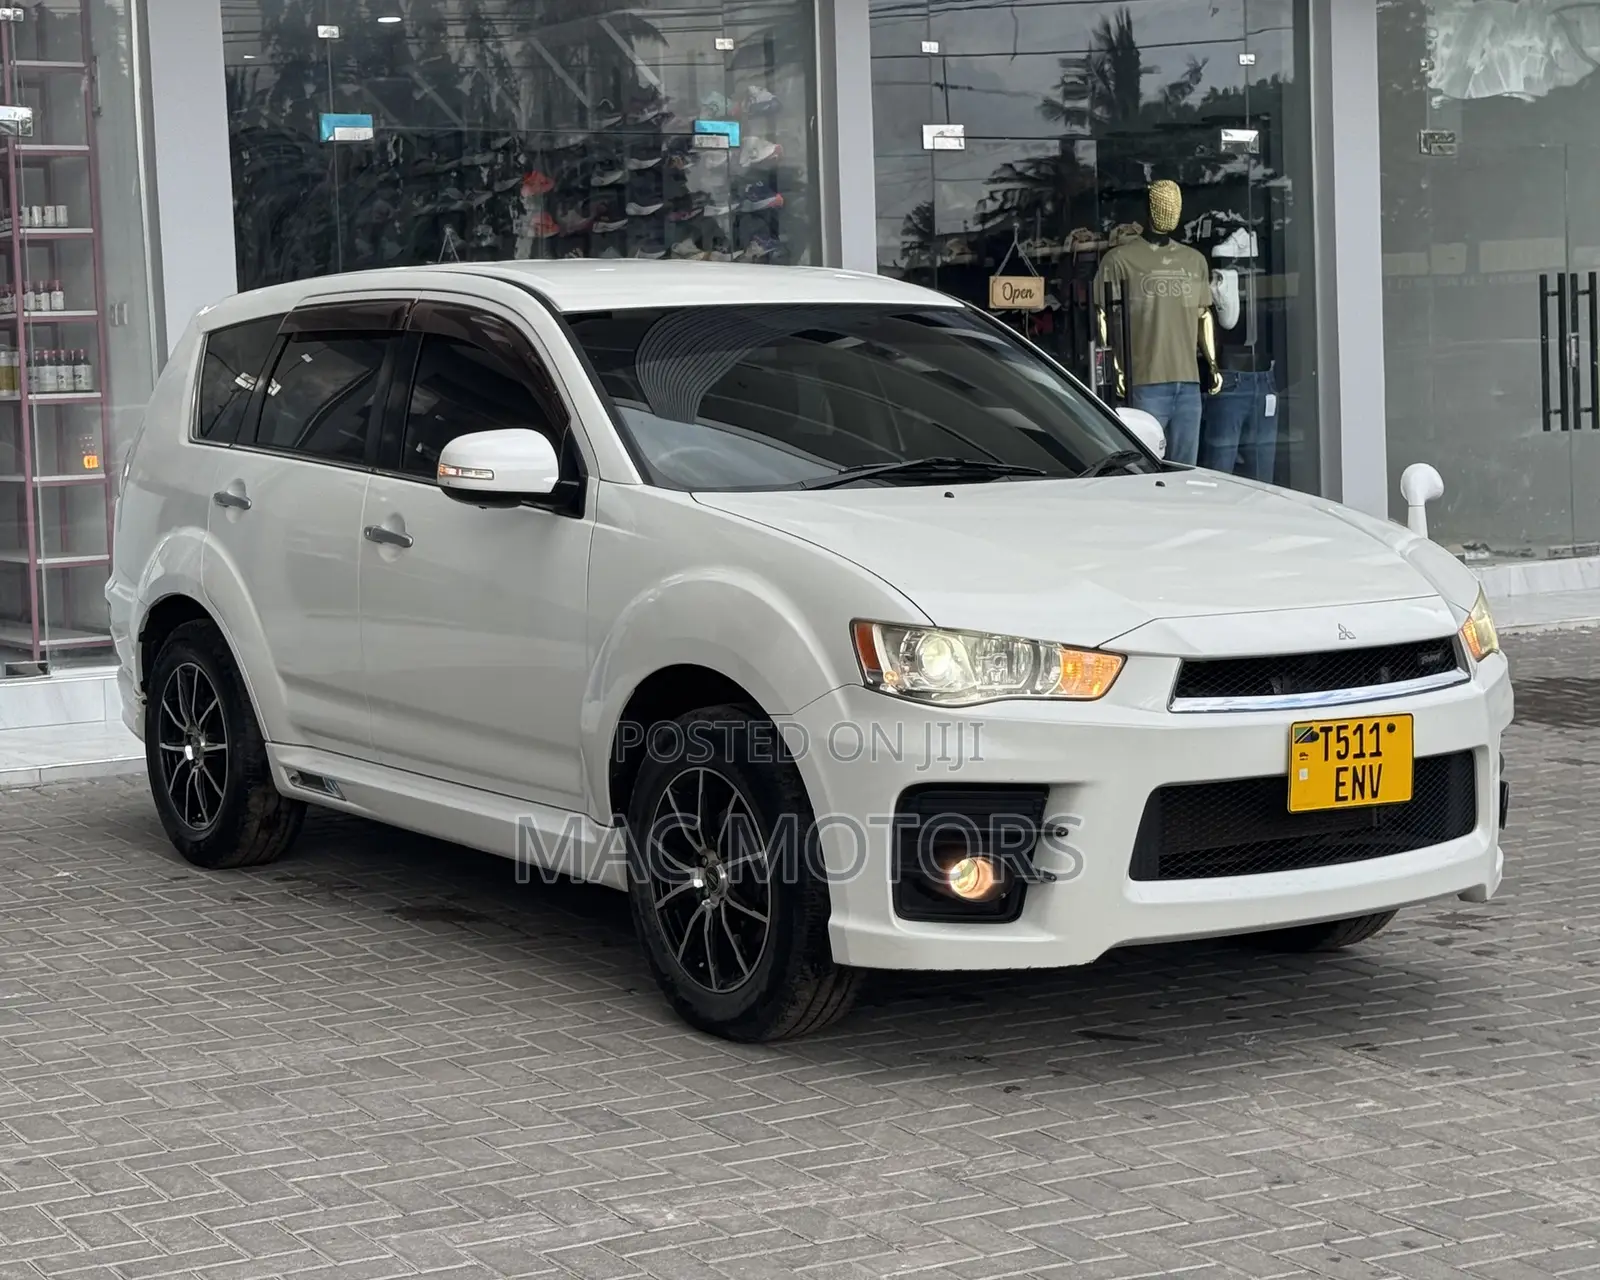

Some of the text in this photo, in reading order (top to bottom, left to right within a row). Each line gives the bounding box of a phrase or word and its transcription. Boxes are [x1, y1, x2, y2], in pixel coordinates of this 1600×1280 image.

[1002, 282, 1035, 304] Open
[1319, 722, 1382, 762] T511
[1334, 763, 1383, 802] ENV
